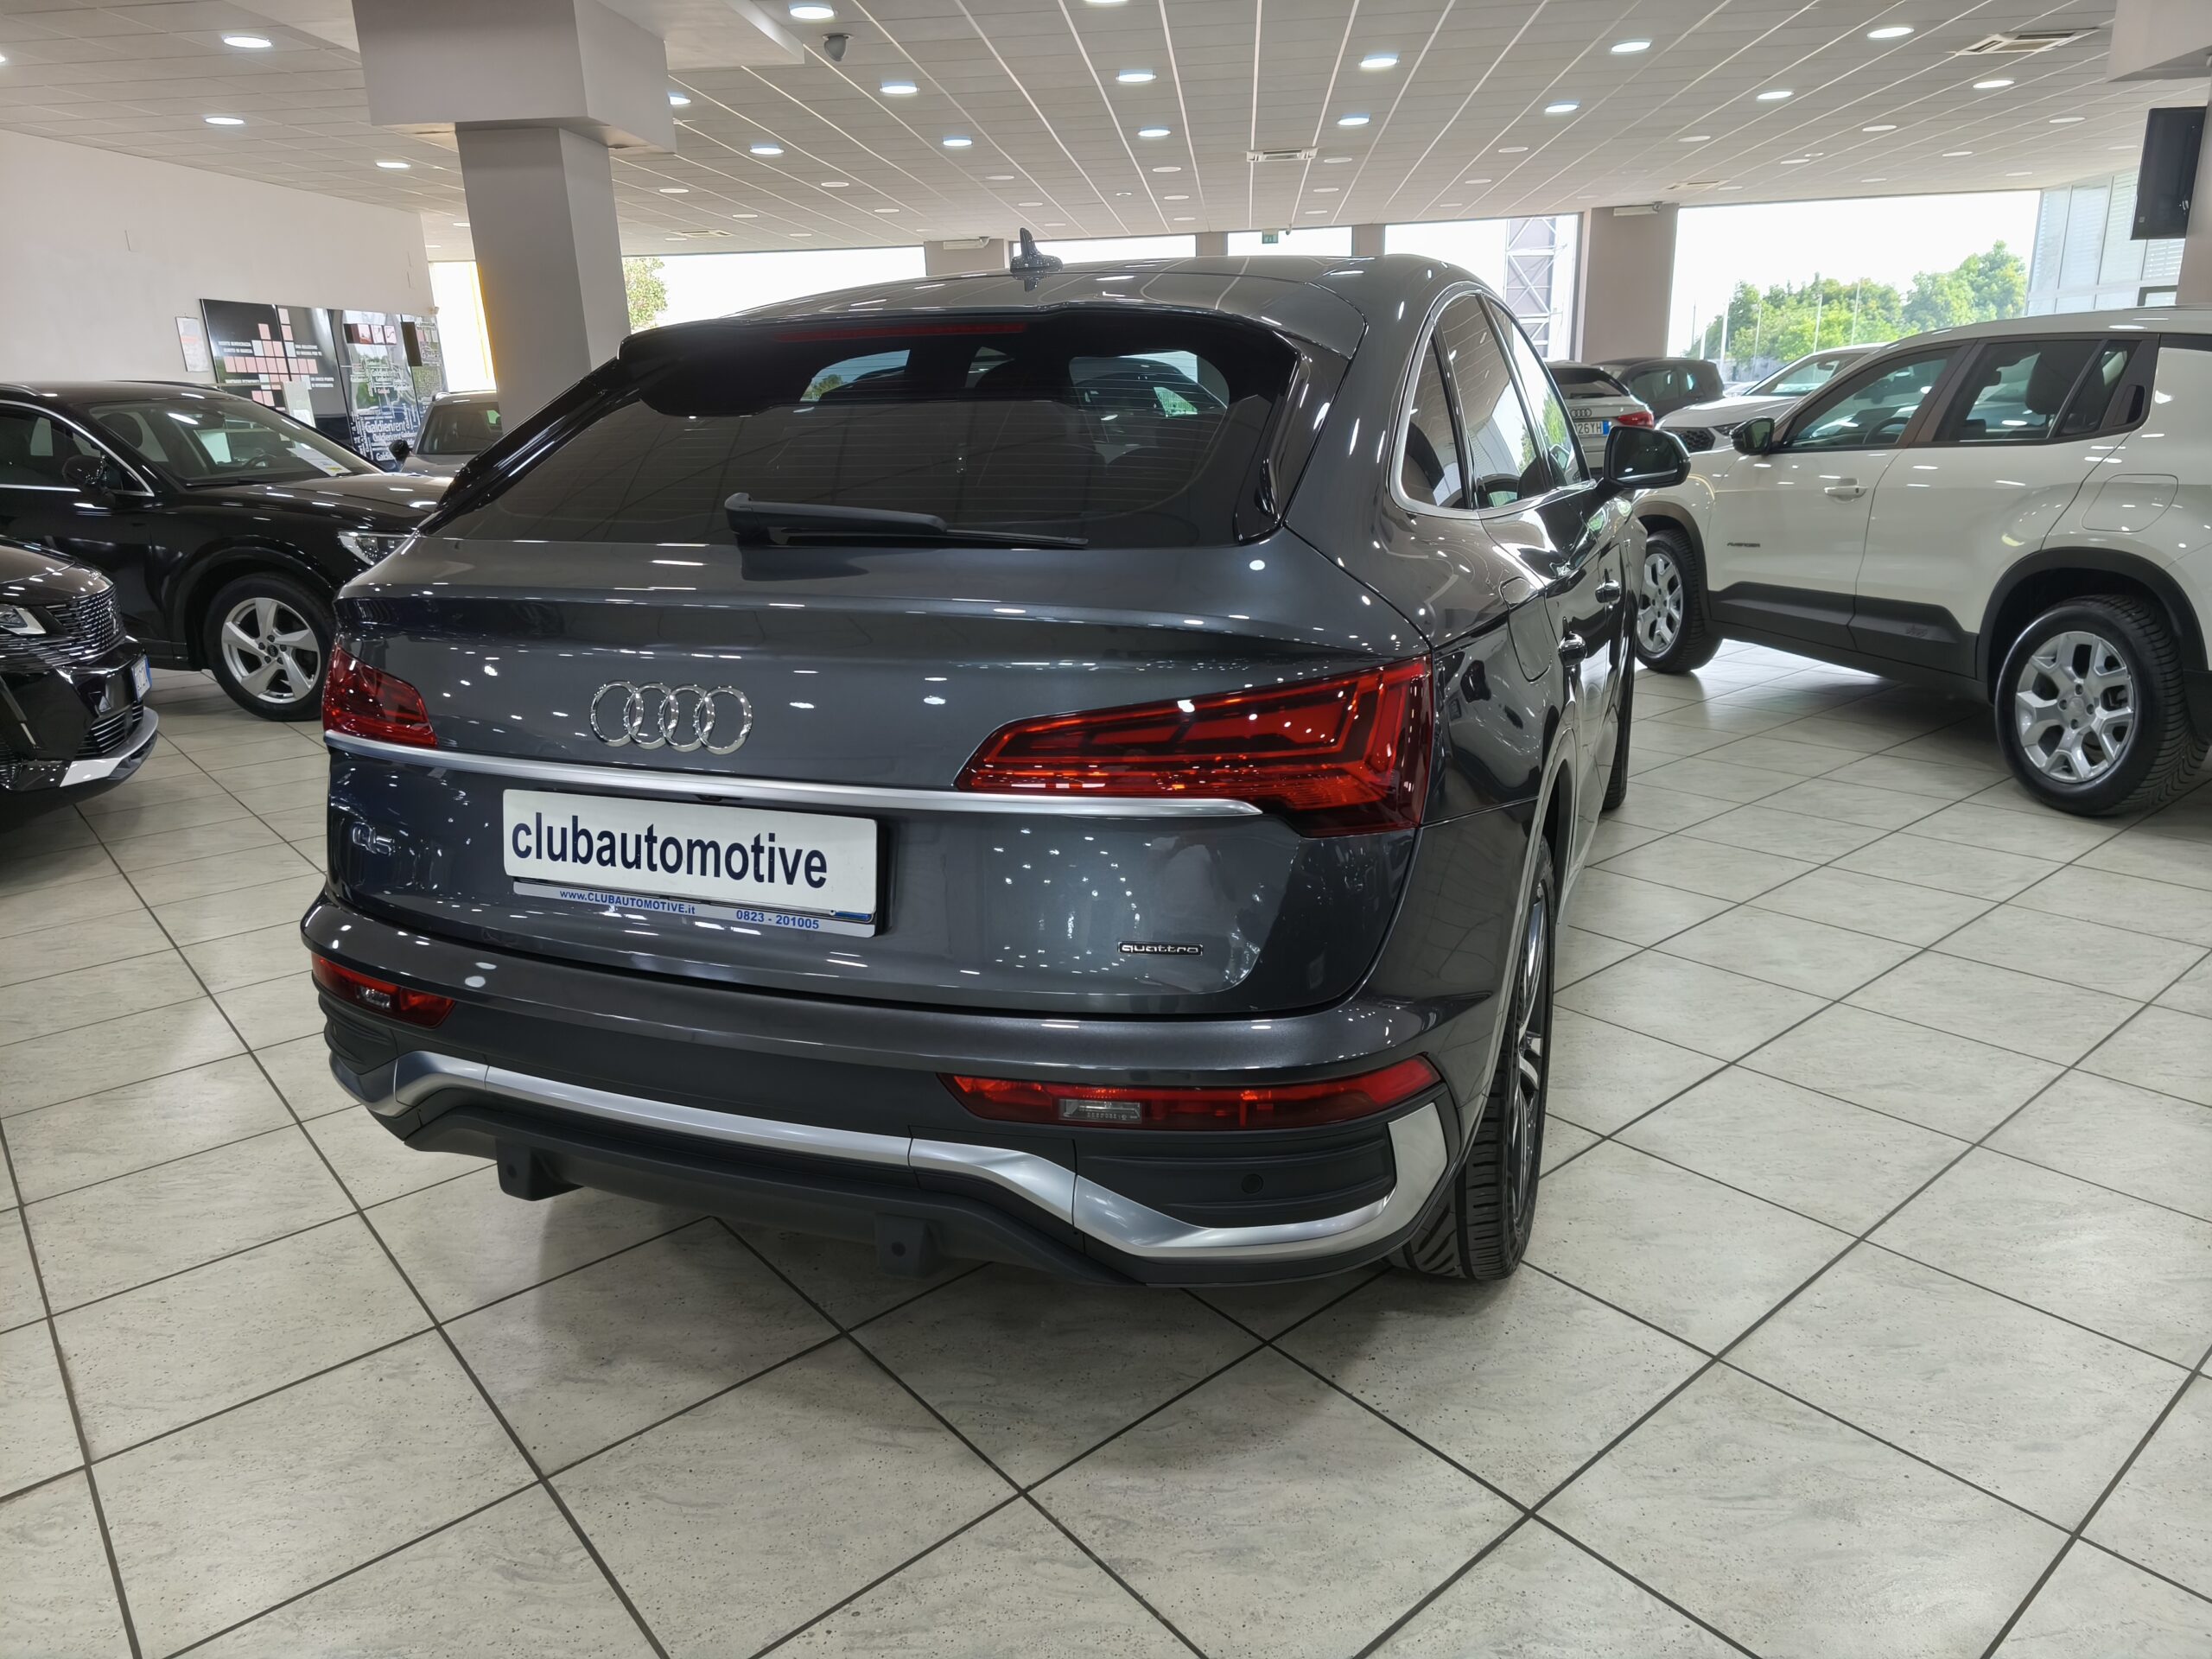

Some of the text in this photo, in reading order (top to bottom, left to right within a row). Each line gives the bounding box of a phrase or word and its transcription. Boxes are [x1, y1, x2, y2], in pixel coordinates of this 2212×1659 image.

[1575, 423, 1602, 435] 26YH
[512, 812, 828, 888] clubautomotive
[560, 891, 696, 914] www.CLUBAUTOMOTIVE.it
[736, 910, 765, 923] 0823
[776, 915, 819, 929] 201005
[1122, 944, 1198, 953] quattro
